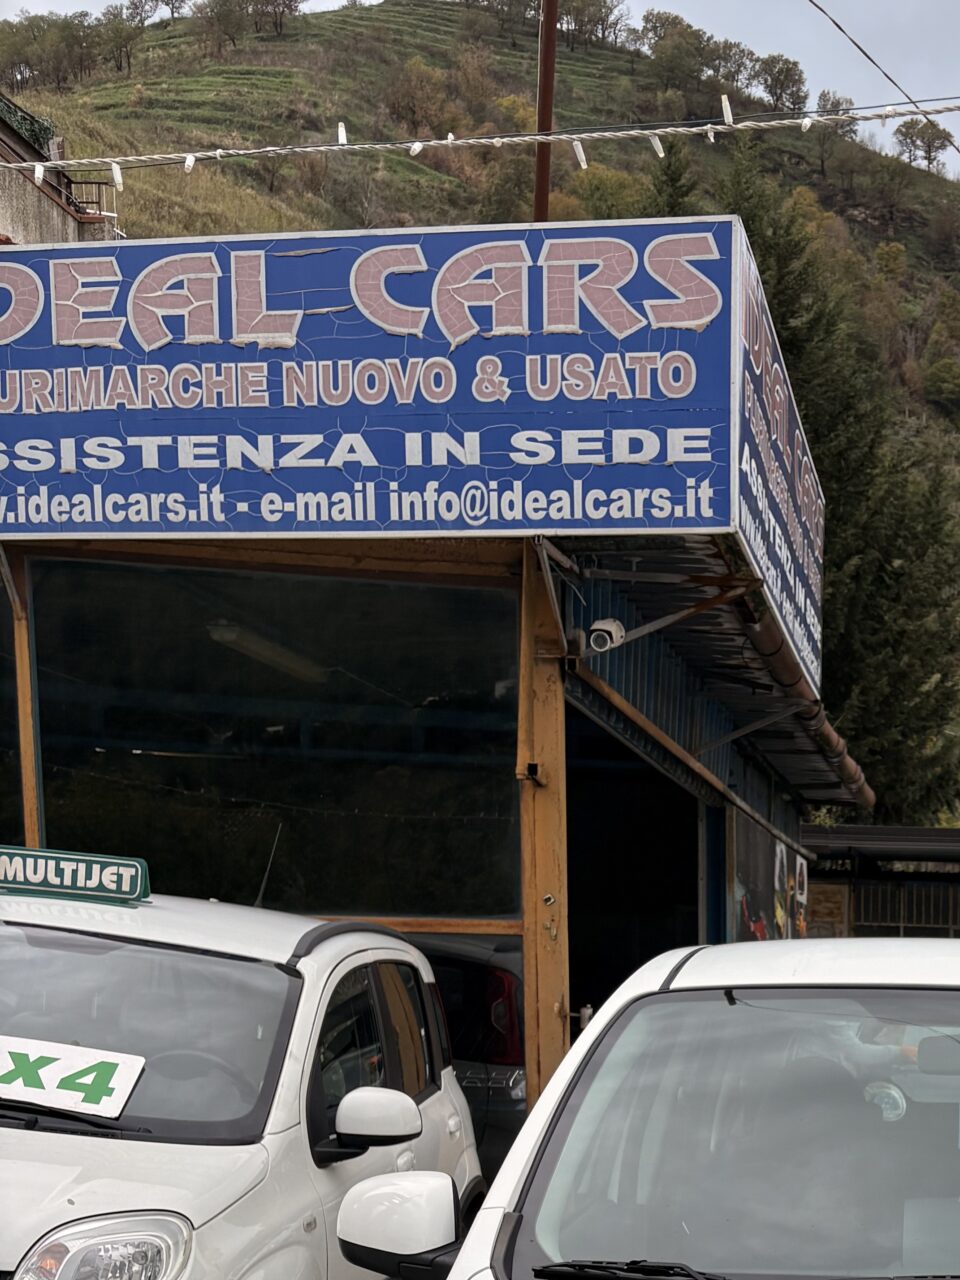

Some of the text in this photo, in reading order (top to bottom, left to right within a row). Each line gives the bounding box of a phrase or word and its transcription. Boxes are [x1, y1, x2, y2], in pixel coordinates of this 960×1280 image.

[350, 233, 723, 351] CARS
[283, 355, 458, 407] NUOVO
[472, 355, 512, 403] &
[526, 350, 697, 401] USATO
[0, 427, 712, 474] SISTENZA IN SEDE
[0, 482, 225, 525] .idealcars.it
[260, 482, 377, 522] e-mail
[389, 478, 714, 526] info@idealcars.it
[0, 855, 136, 892] MULTIJET
